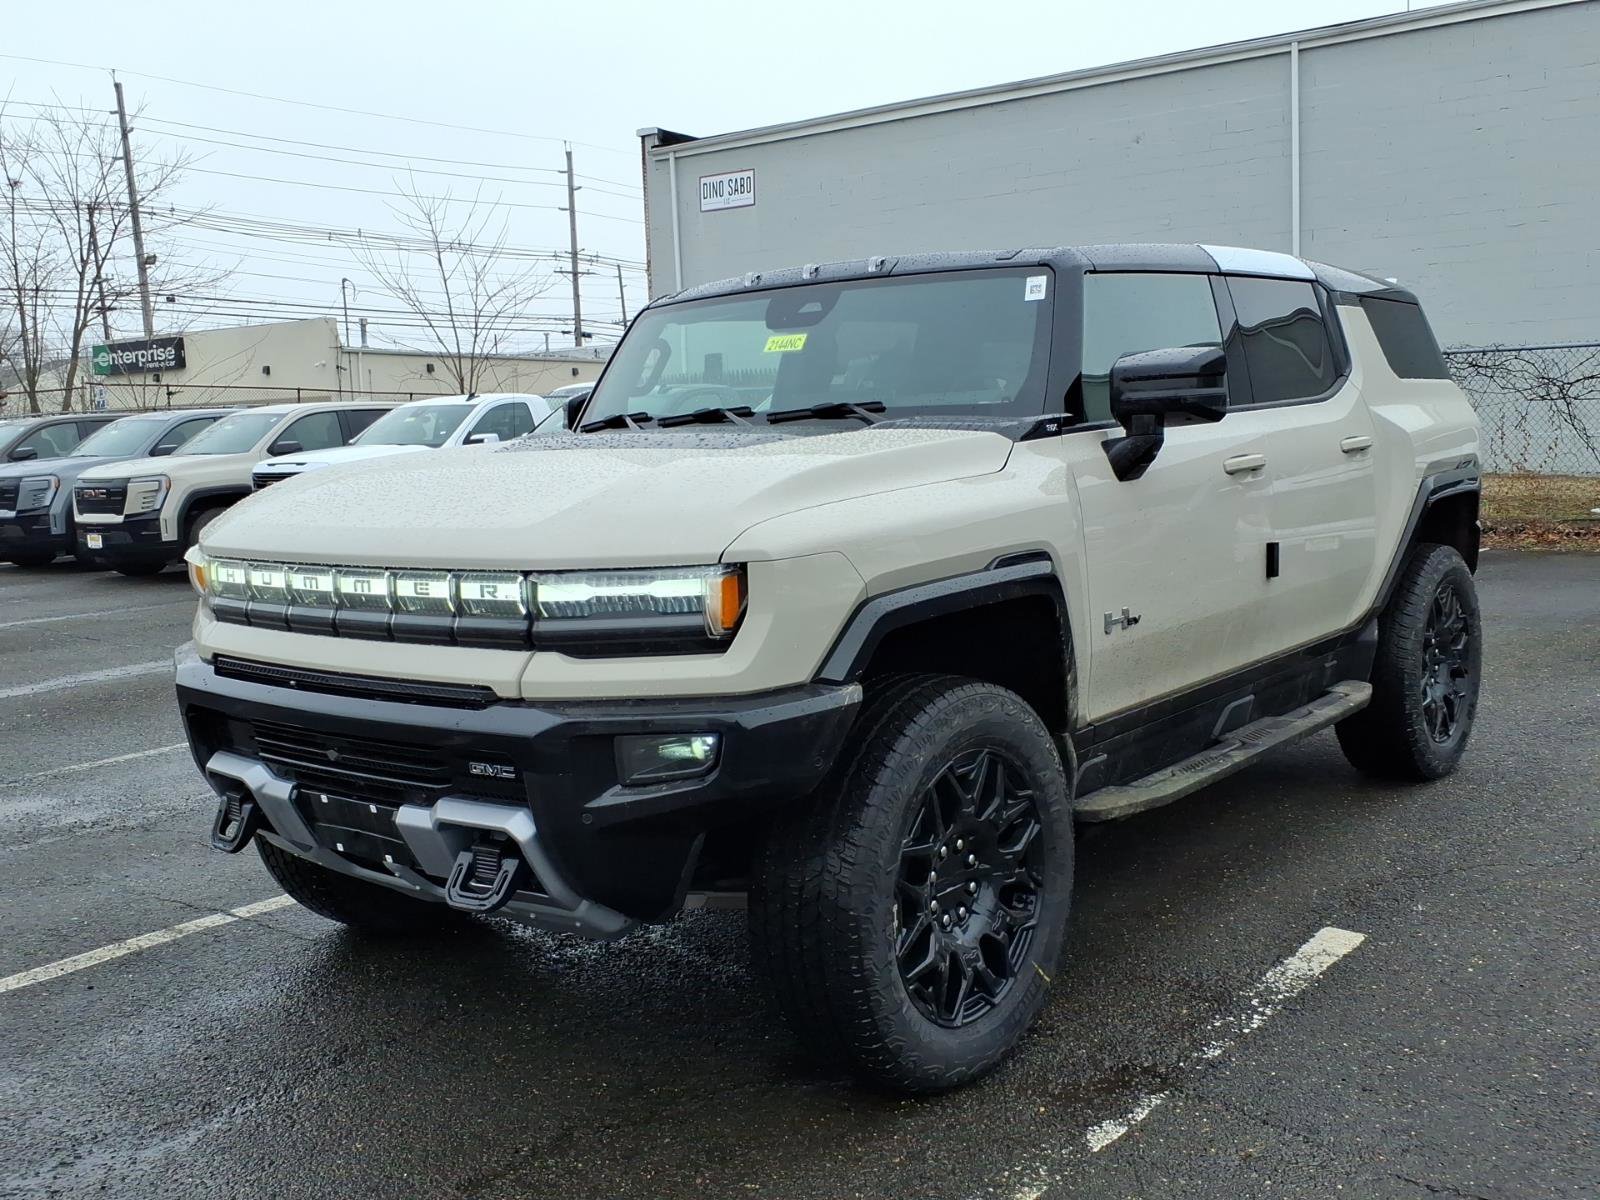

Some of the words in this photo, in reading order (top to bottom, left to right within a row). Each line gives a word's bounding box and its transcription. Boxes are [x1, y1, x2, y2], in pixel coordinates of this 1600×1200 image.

[702, 180, 724, 200] DINO
[727, 176, 752, 196] SABO
[97, 344, 176, 368] enterprise
[146, 360, 176, 369] rent-a-car
[226, 566, 498, 599] HUMMER
[469, 761, 516, 779] GMC
